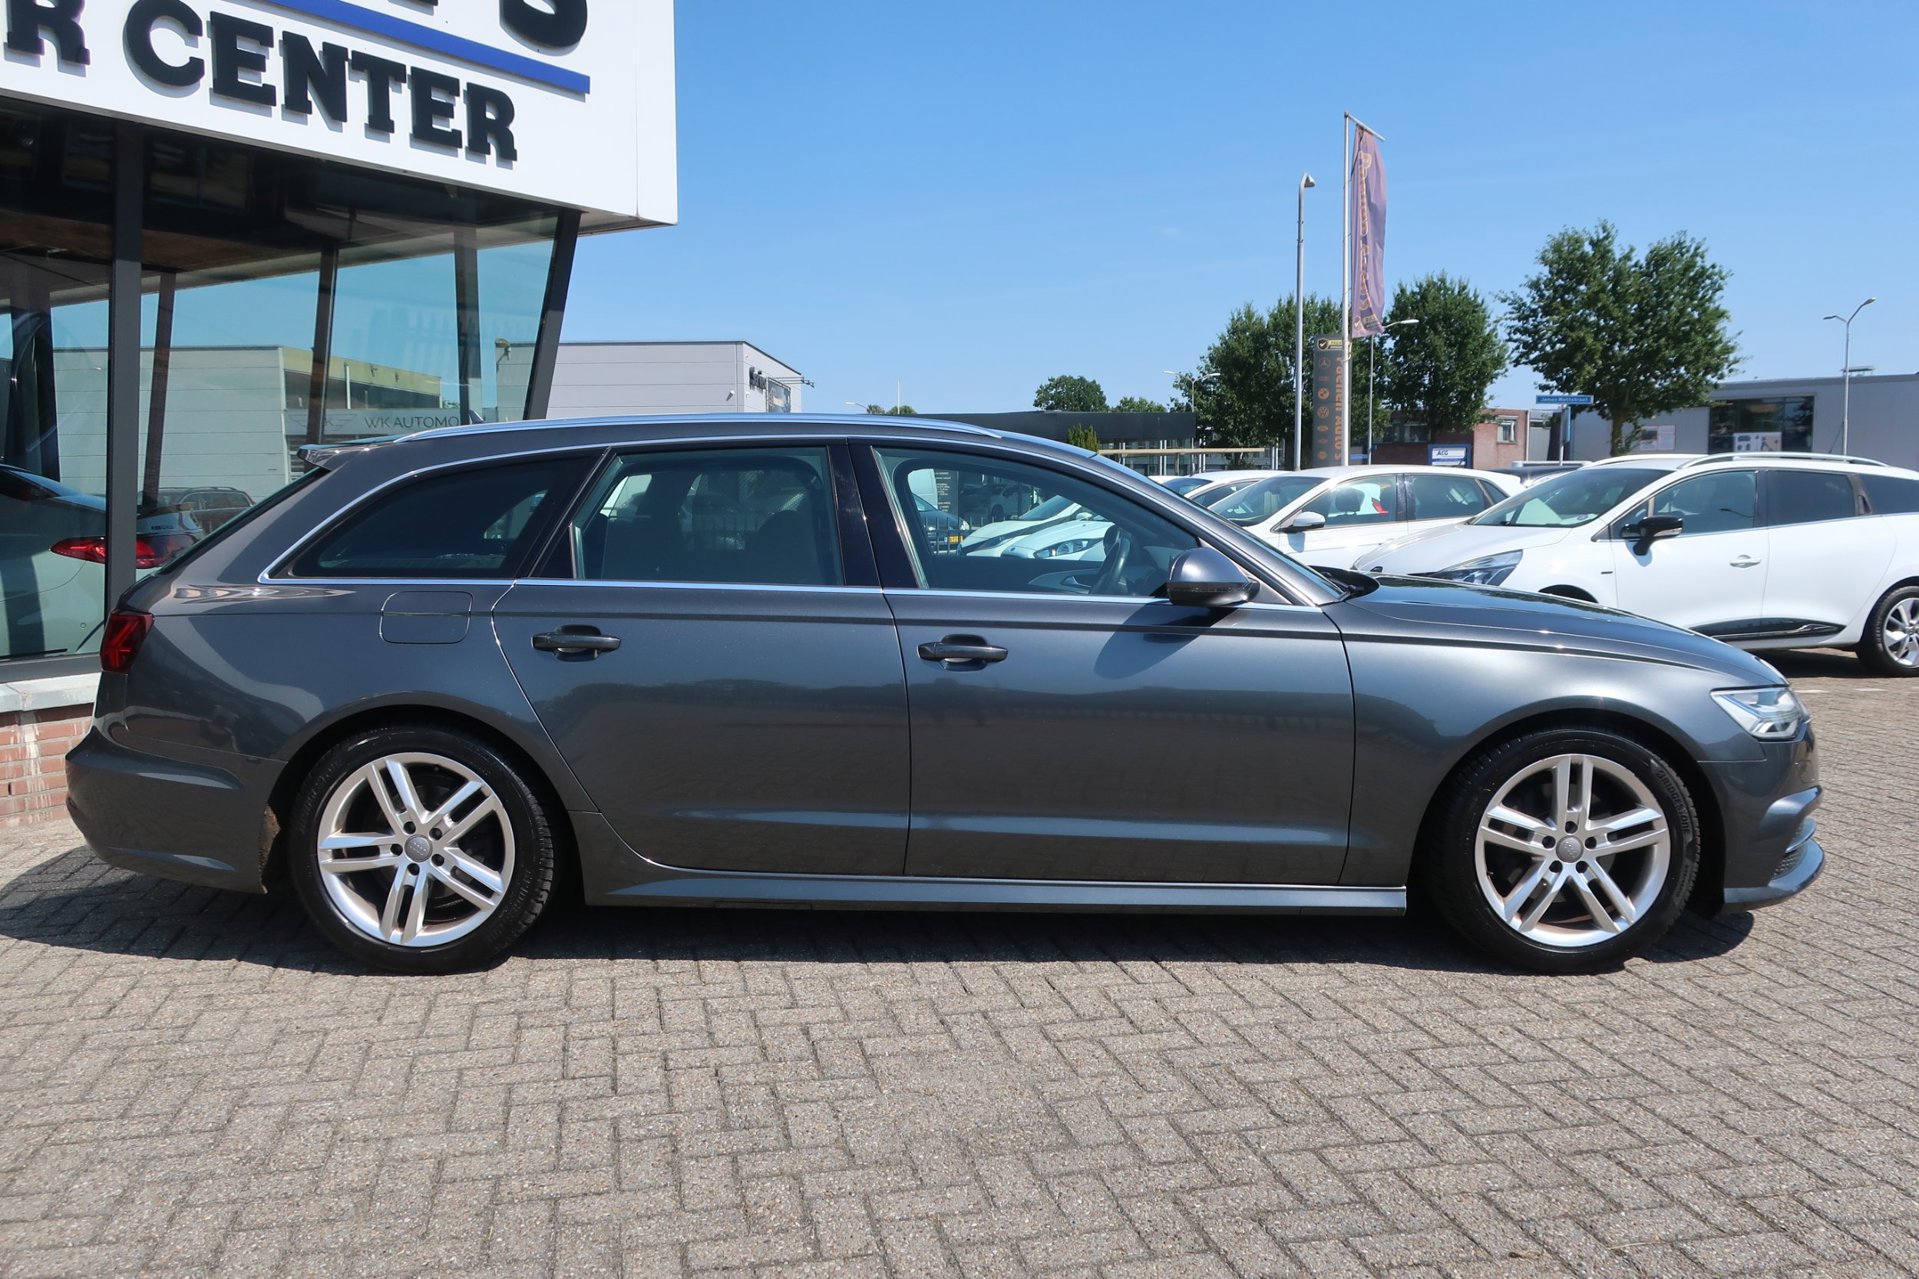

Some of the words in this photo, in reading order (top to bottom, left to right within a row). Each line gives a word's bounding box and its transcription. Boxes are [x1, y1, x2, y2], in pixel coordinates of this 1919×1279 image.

[124, 0, 518, 162] CENTER
[364, 416, 393, 429] WK
[394, 416, 460, 429] AUTOMO
